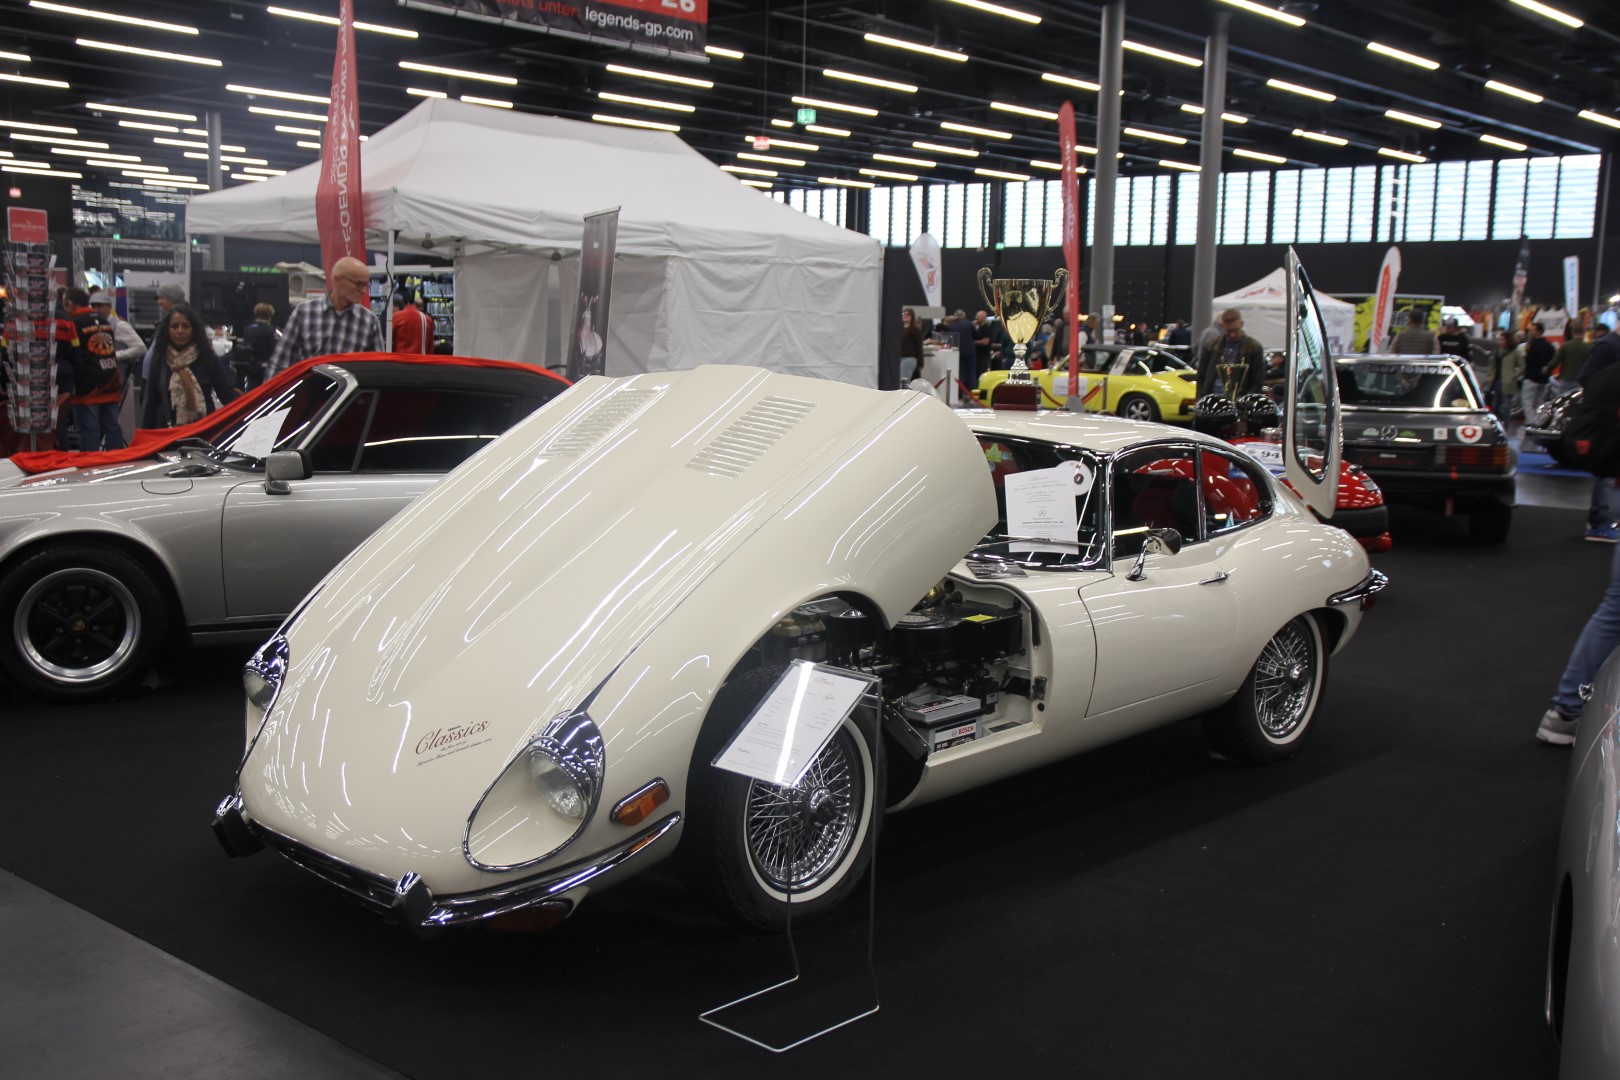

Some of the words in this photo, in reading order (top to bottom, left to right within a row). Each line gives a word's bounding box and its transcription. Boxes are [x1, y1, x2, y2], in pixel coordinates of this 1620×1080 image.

[538, 0, 580, 17] unter:
[585, 5, 694, 42] legends-gp.com
[1261, 450, 1281, 459] 94
[415, 720, 492, 755] Classics
[959, 725, 974, 735] BOSCH
